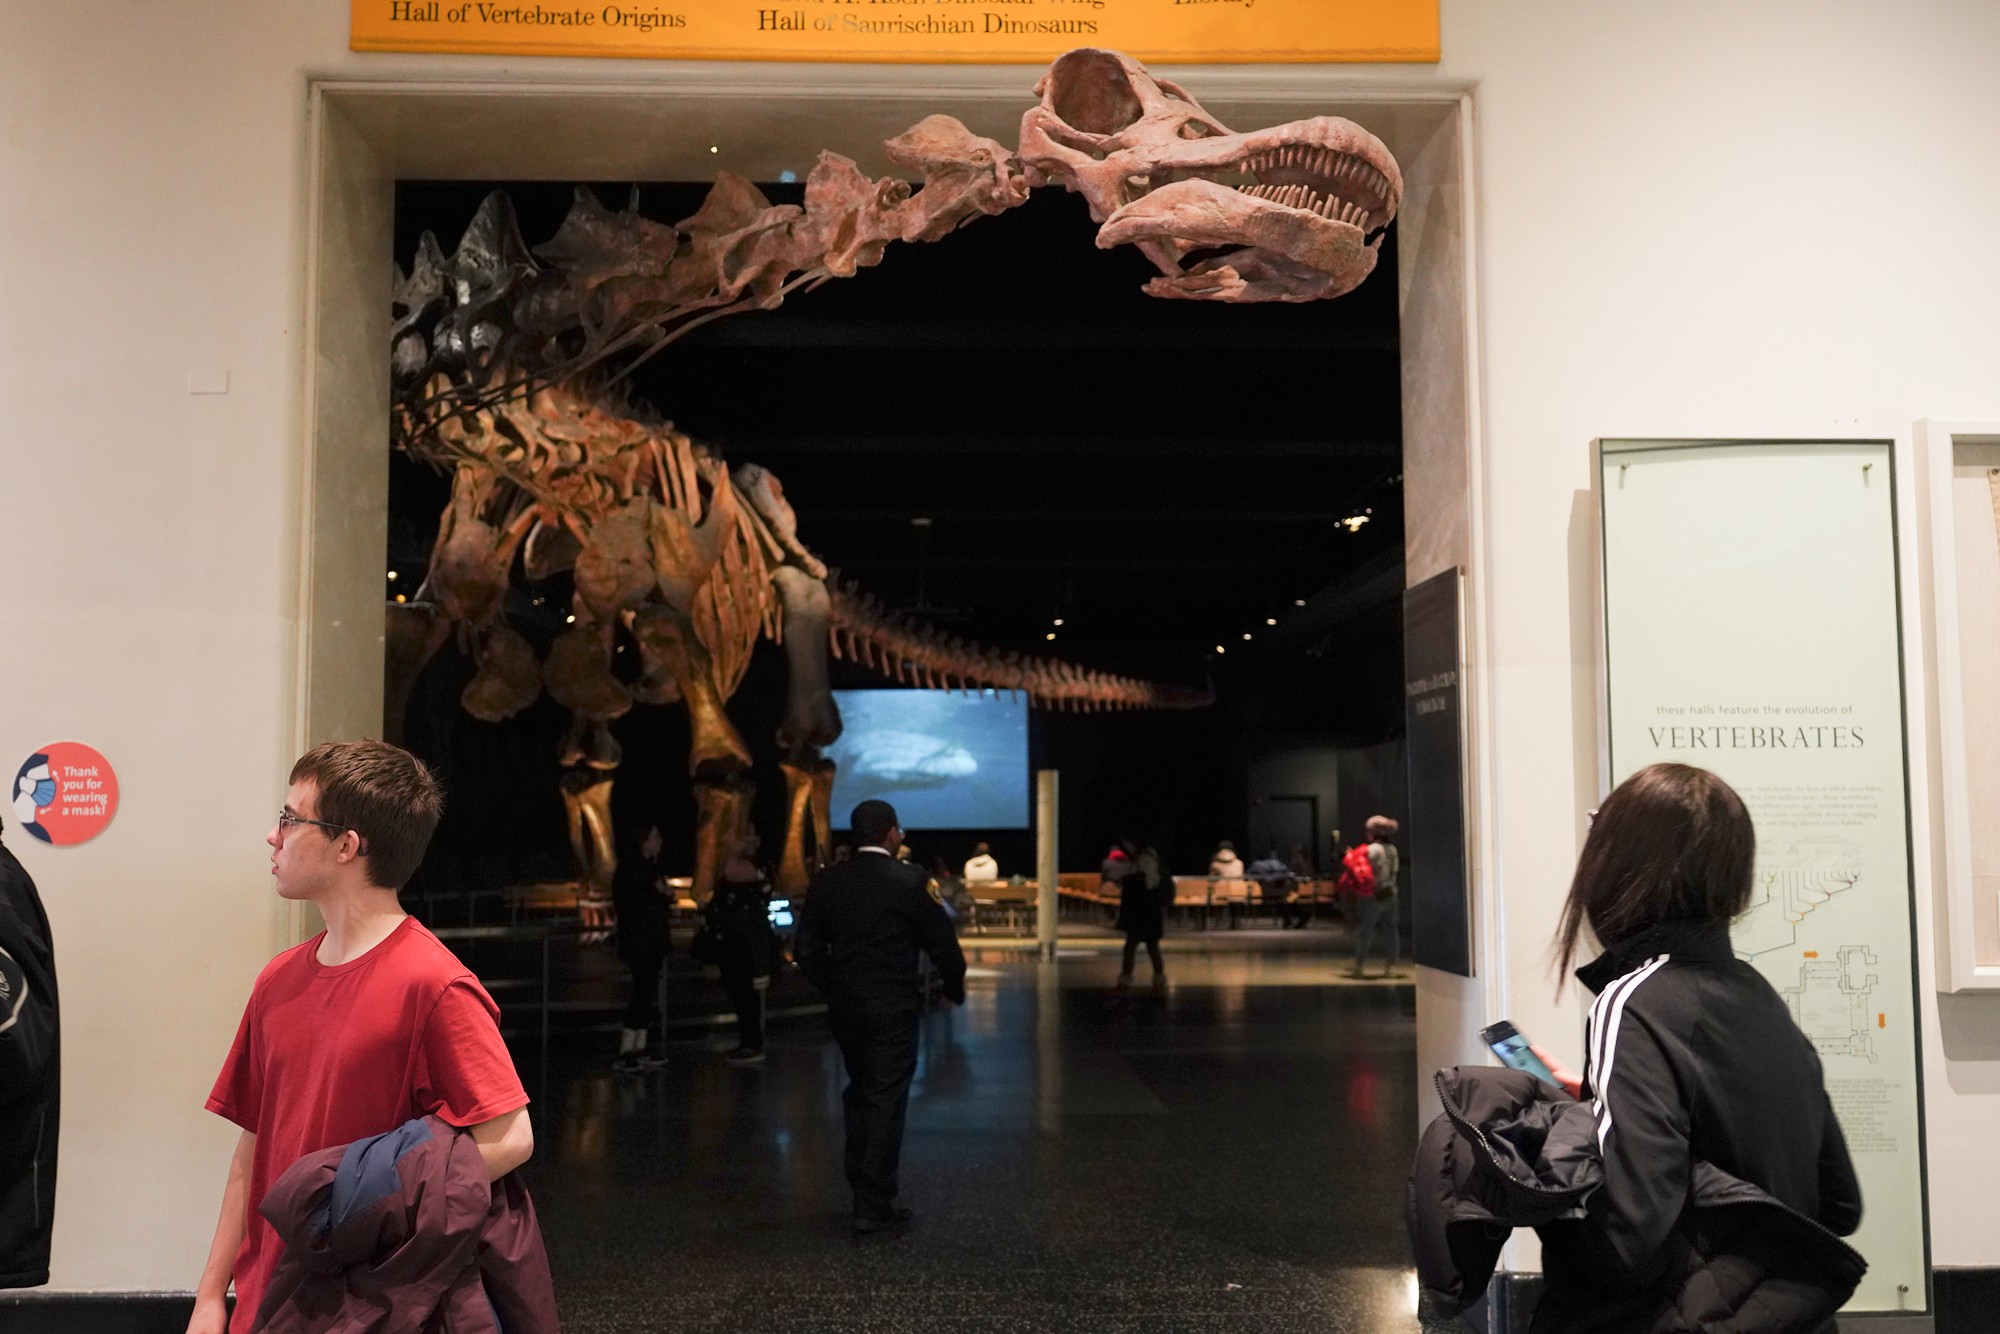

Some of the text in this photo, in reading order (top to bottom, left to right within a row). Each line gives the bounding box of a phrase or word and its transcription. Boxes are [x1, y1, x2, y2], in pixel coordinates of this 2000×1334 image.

[390, 1, 687, 32] Hall of Vertebrate Origins
[757, 9, 1098, 35] Hall of Saurischian Dinosaurs
[1656, 704, 1853, 715] these halls feature the evolution of
[1648, 726, 1864, 749] VERTEBRATES
[64, 766, 98, 777] Thank
[63, 778, 103, 792] you for
[62, 793, 108, 805] wearing
[62, 804, 105, 817] a mask!
